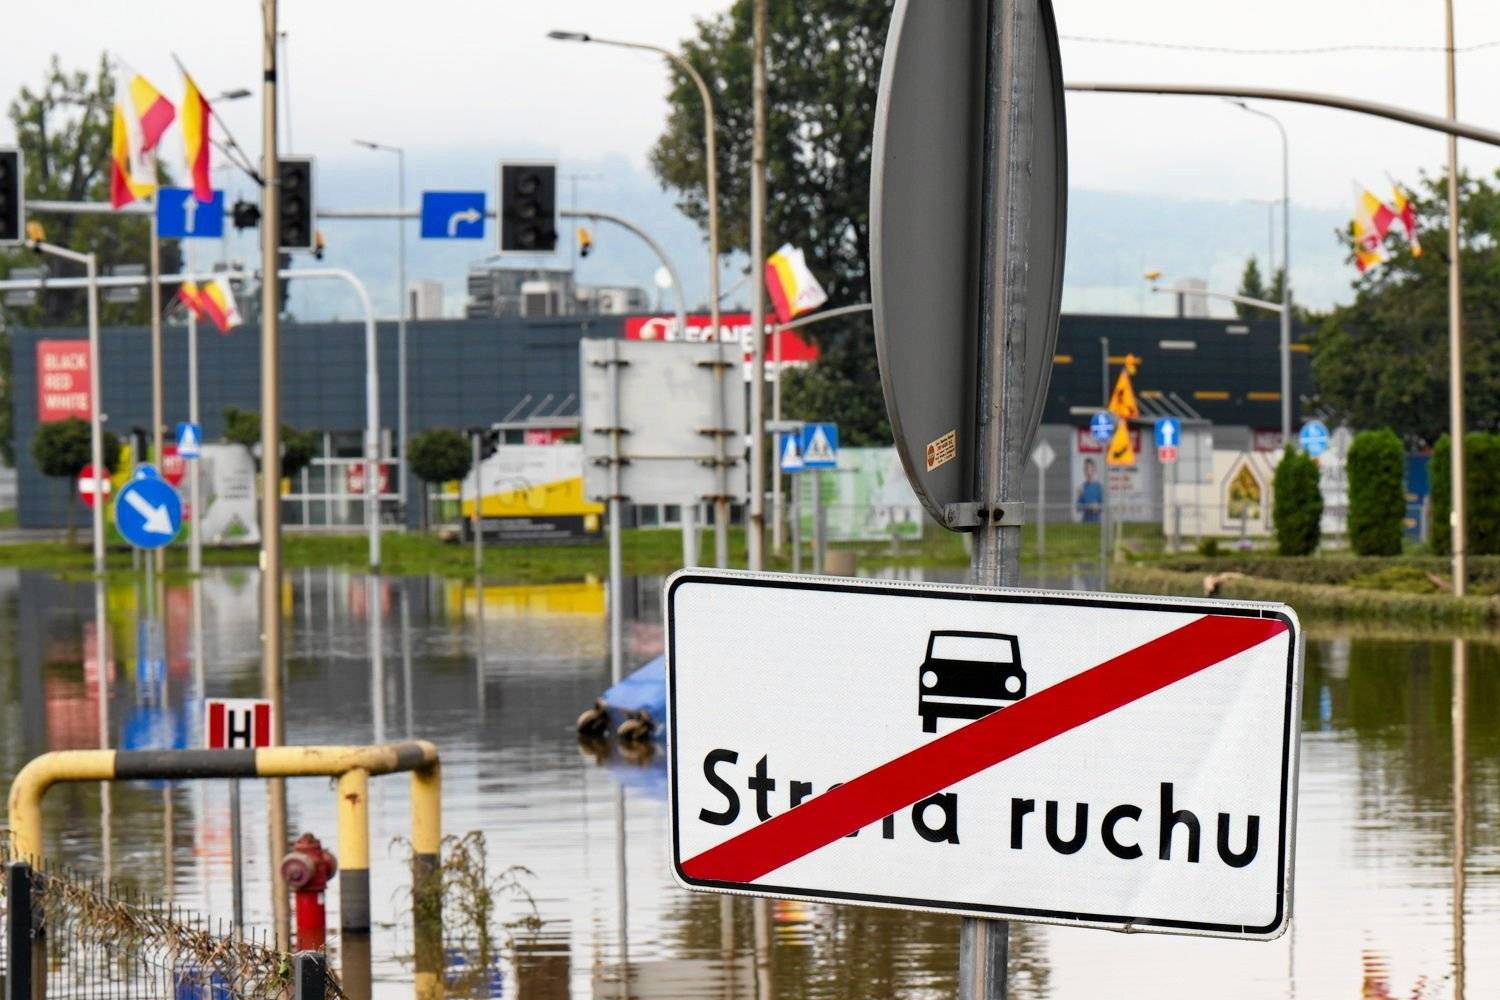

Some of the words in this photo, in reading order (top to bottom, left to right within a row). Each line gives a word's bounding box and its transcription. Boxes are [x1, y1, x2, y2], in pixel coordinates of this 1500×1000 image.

[44, 393, 88, 411] WHITE
[228, 709, 252, 749] H
[698, 747, 961, 845] Stra
[1010, 782, 1260, 868] ruchu
